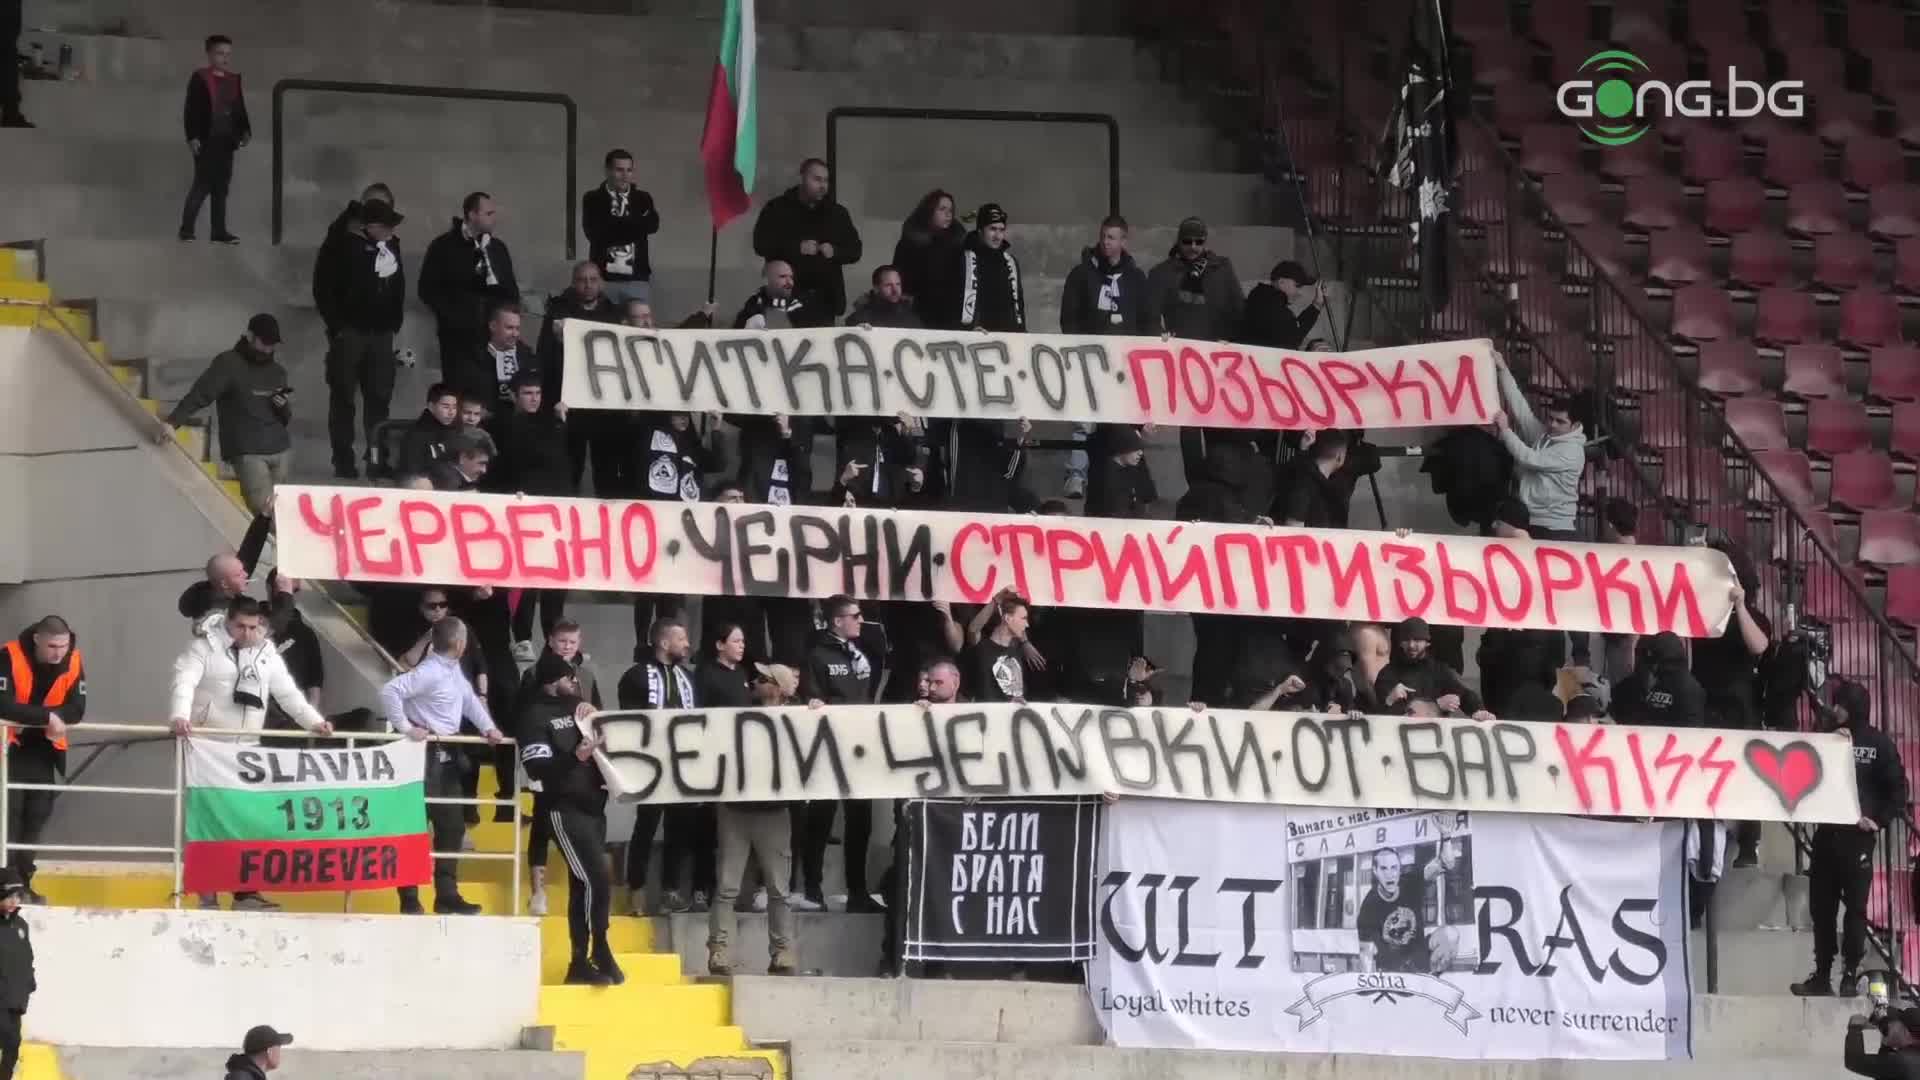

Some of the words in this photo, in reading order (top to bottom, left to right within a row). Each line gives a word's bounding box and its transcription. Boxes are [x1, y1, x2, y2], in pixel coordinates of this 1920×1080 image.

[584, 329, 881, 412] АГИТКА
[893, 338, 1014, 411] СТЕ
[1032, 343, 1110, 411] ОТ
[1128, 347, 1487, 427] ПОЗЬОРКИ
[299, 492, 657, 581] ЧЕРВЕНО
[681, 505, 934, 598] ЧЕРНИ
[950, 522, 1712, 639] СТРИЙПТИЗЬОРКИ
[236, 750, 395, 784] SLAVIA
[1291, 718, 1370, 802] ОТ
[1400, 721, 1537, 803] БАР
[277, 795, 371, 832] 1913
[961, 812, 1040, 851] БЕЛИ
[239, 845, 397, 884] FOREVER
[951, 854, 1044, 893] БРАТЯ
[952, 896, 965, 934] С
[986, 896, 1041, 934] НАС
[1100, 987, 1167, 1017] Loyal
[1169, 991, 1251, 1017] whites
[1490, 1006, 1556, 1026] never
[1562, 1008, 1679, 1034] surrender
